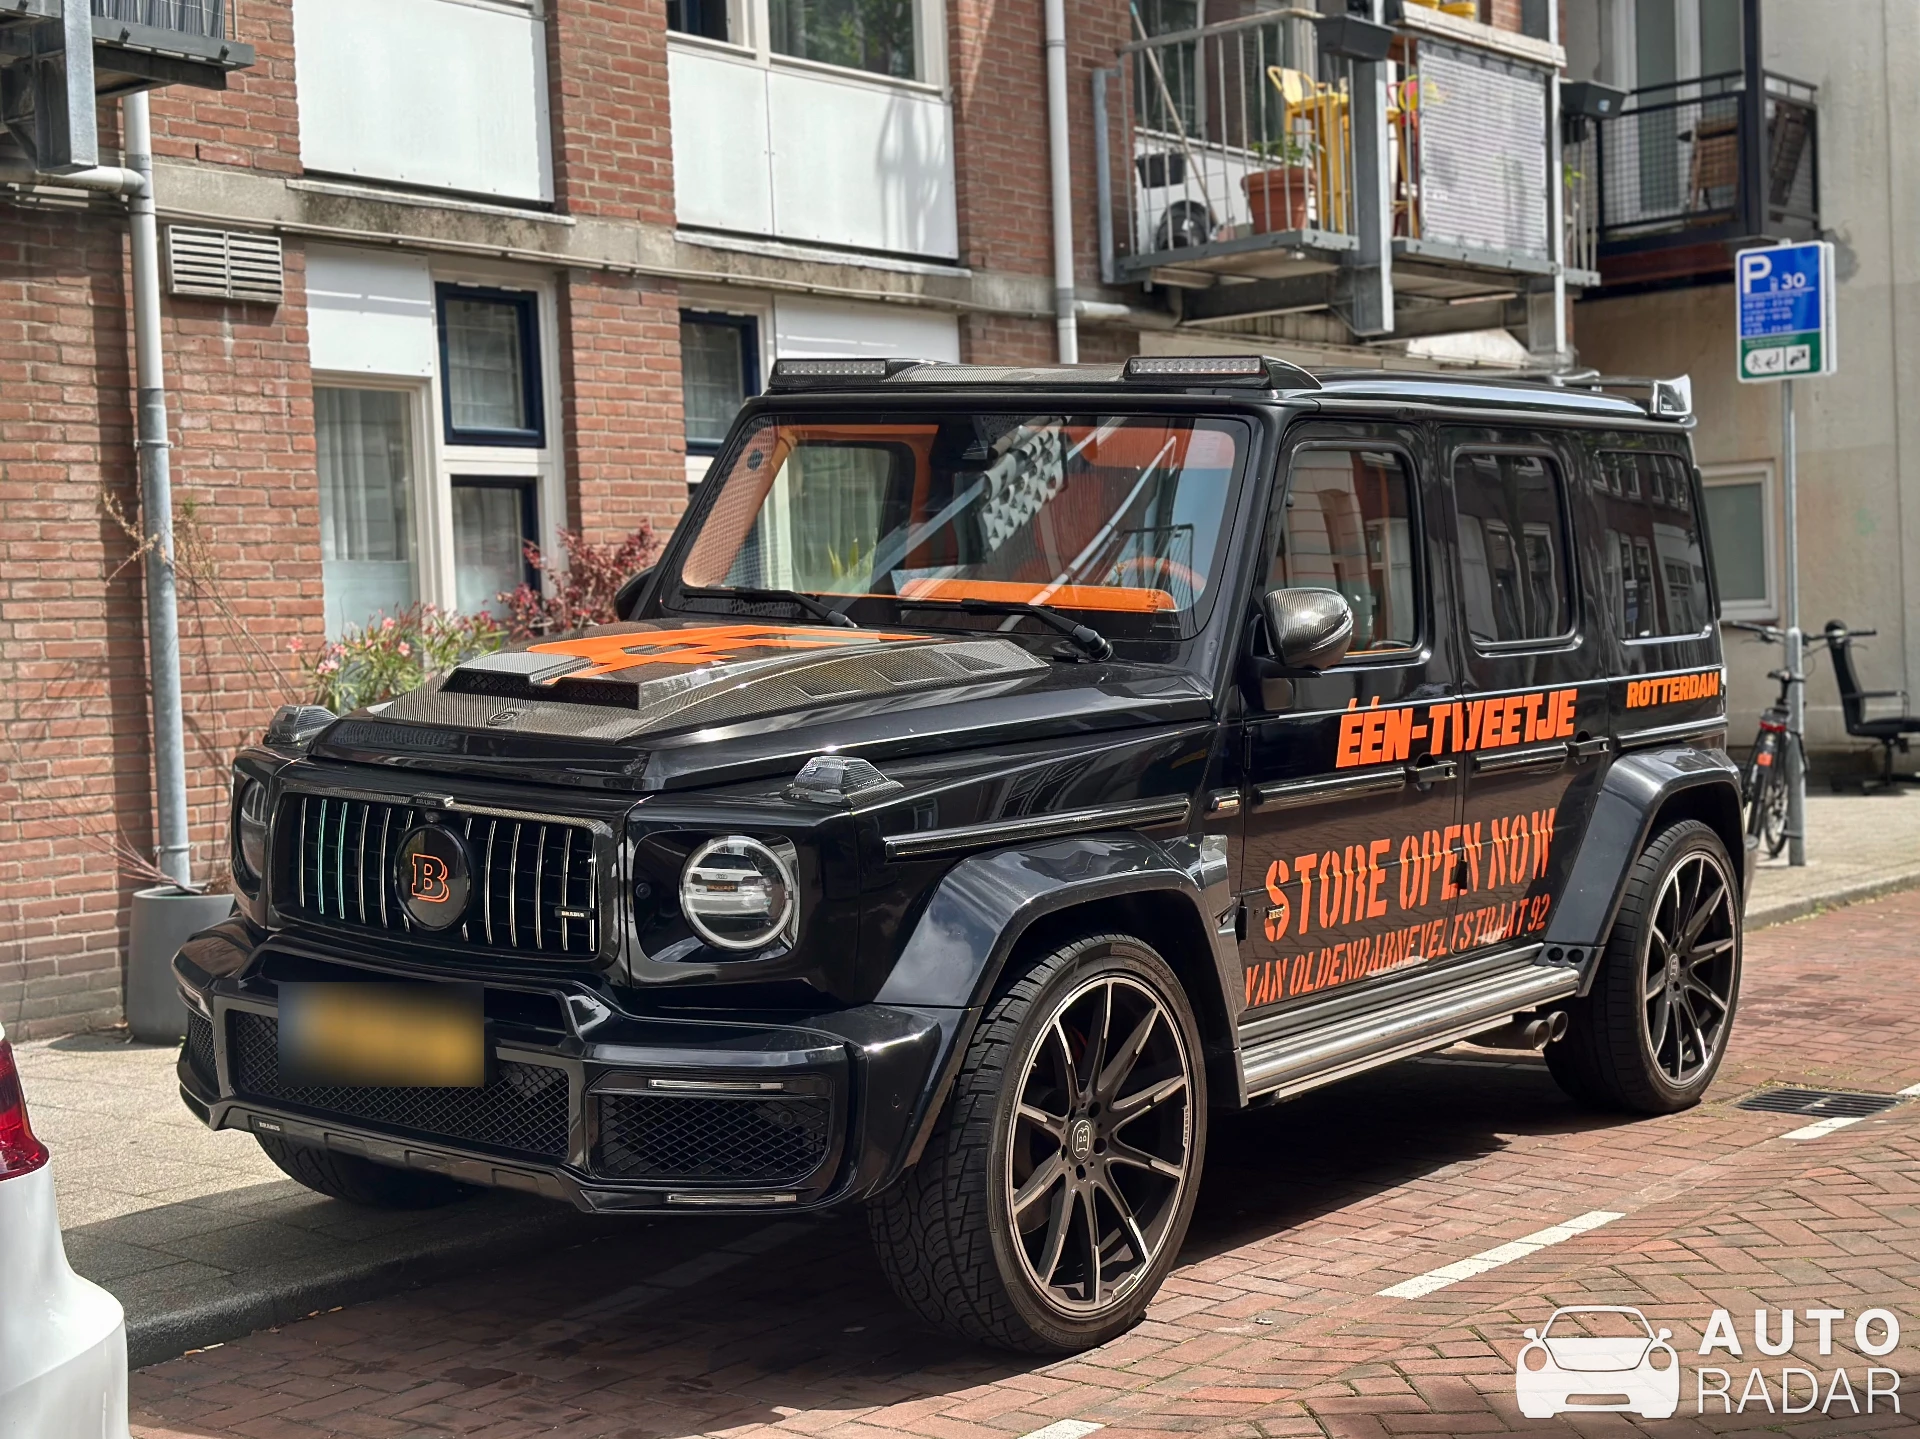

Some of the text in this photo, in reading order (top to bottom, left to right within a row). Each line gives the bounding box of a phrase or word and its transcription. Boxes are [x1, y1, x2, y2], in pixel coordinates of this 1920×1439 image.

[1742, 255, 1806, 294] P 30
[1626, 671, 1719, 708] ROTTERDAM
[1336, 688, 1578, 768] ÉÉN-TWEETJE
[411, 853, 450, 903] B
[1264, 807, 1556, 942] STORE OPEN NOW
[1246, 958, 1290, 1007] VAN
[1530, 893, 1551, 932] 92
